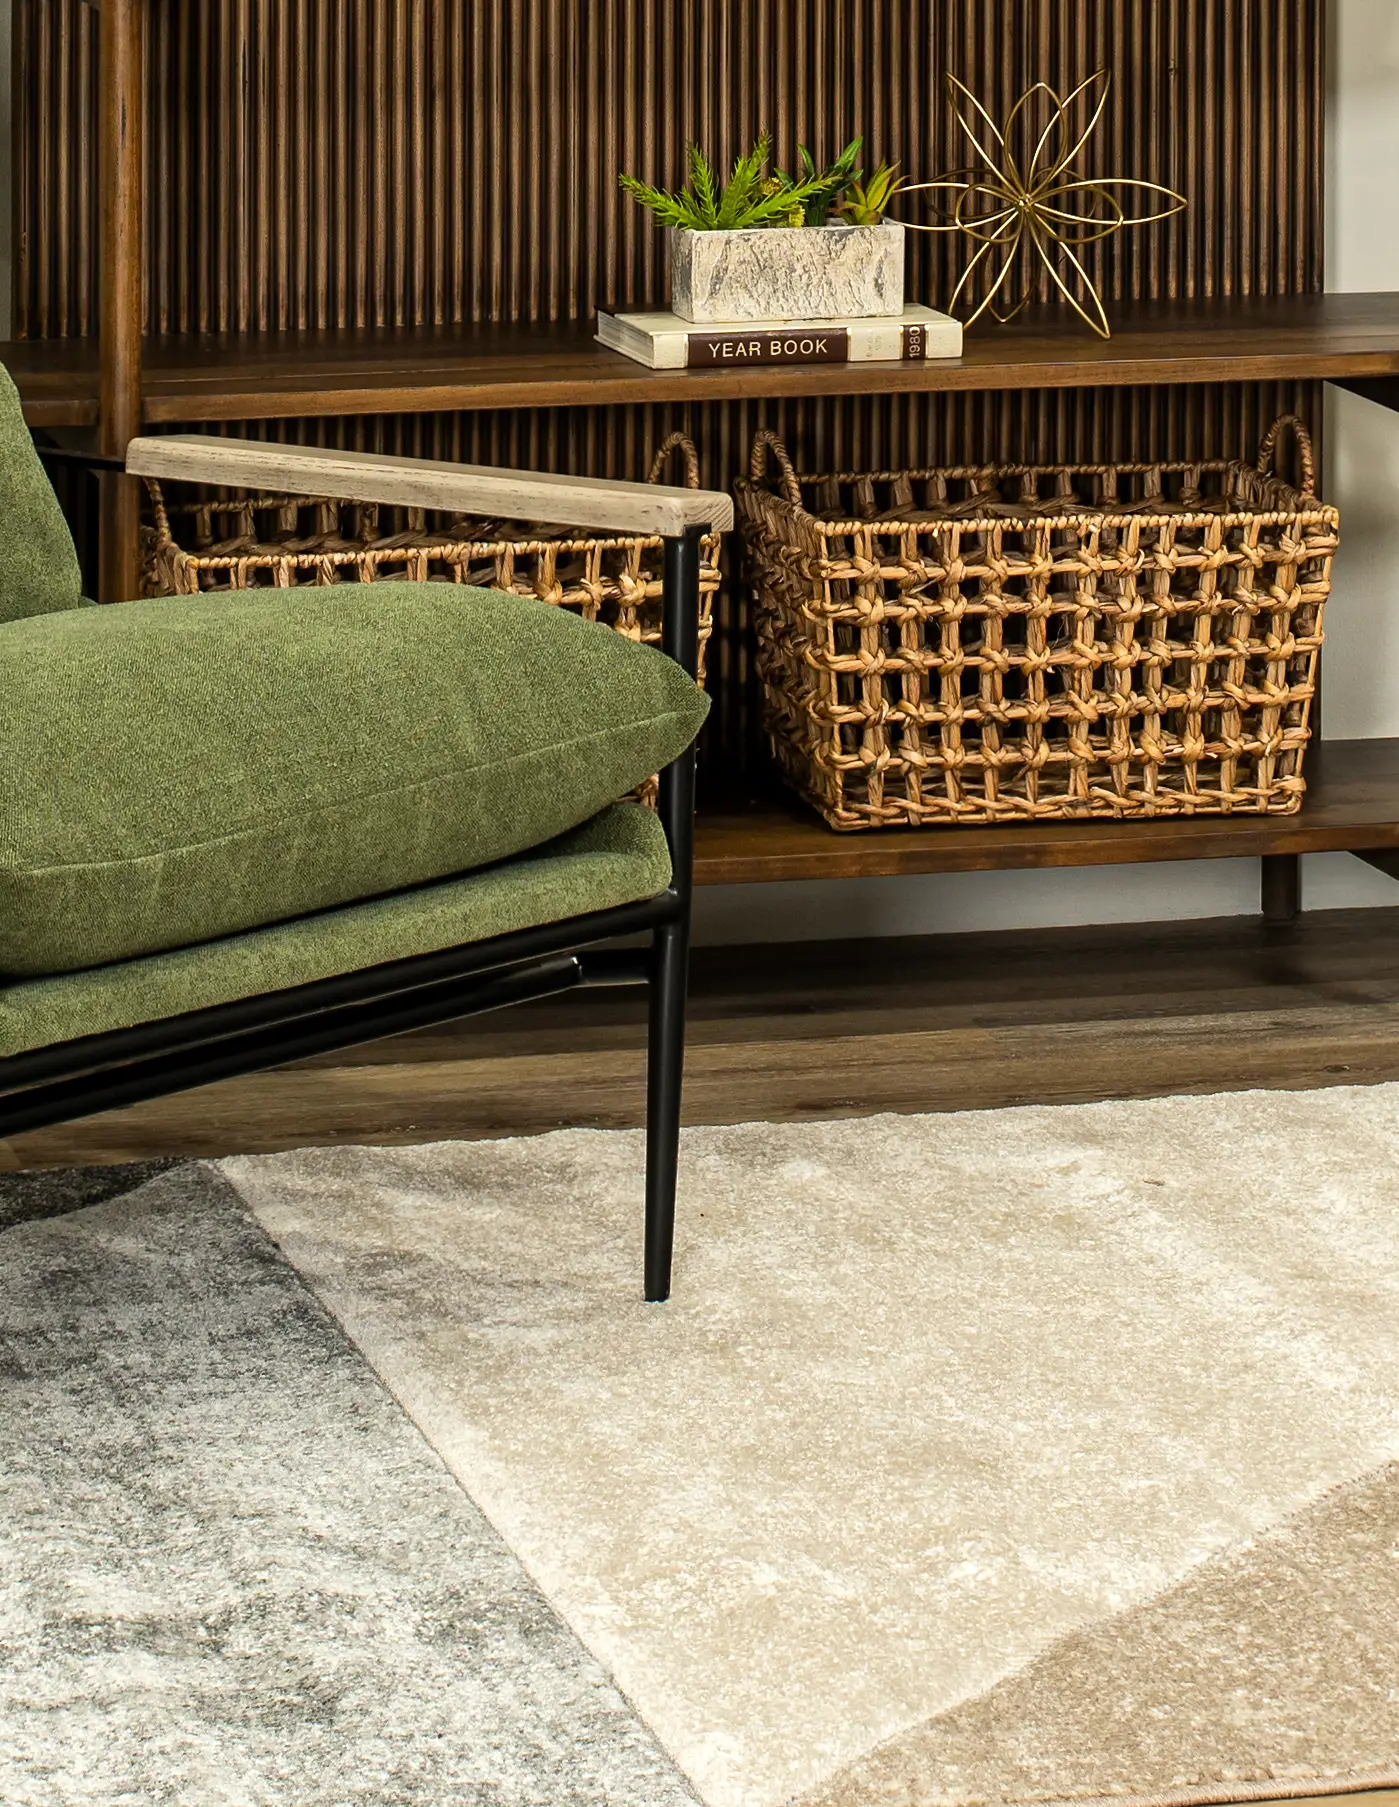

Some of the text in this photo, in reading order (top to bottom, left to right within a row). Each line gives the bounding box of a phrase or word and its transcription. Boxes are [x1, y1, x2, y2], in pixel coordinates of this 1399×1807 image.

[708, 338, 828, 359] YEAR BOOK
[908, 325, 921, 358] 1980
